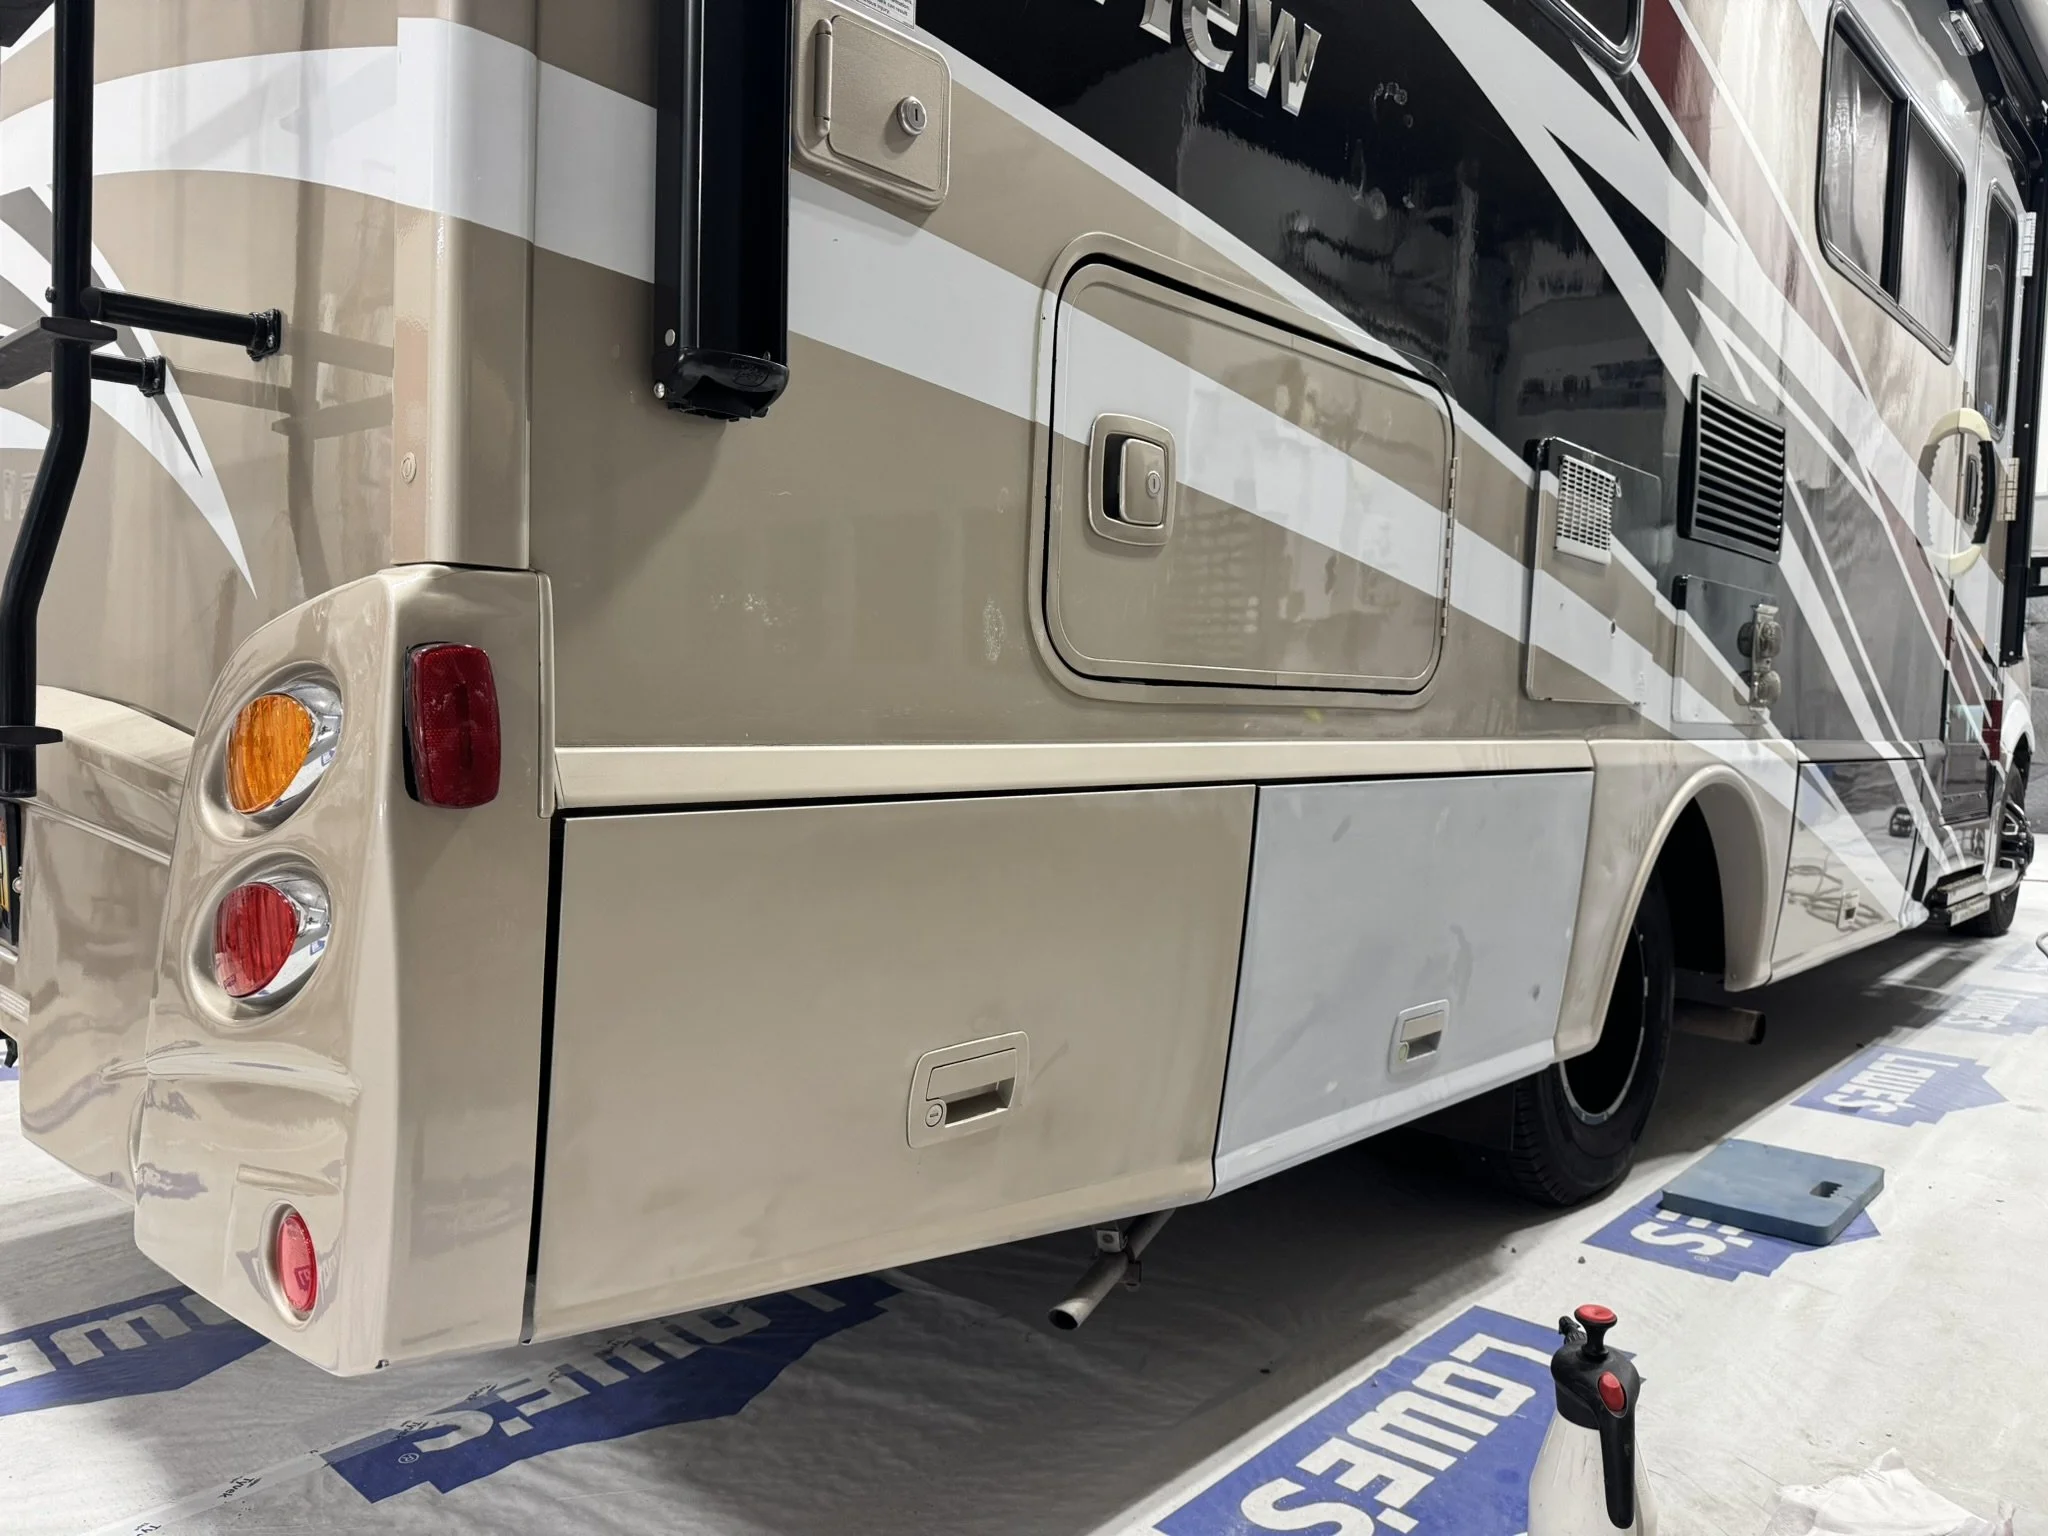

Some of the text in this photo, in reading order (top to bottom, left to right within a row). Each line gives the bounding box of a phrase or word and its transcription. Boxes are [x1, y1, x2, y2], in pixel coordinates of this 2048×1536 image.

[1095, 0, 1321, 117] ew
[1823, 1052, 1960, 1114] LOWE'S
[1241, 1332, 1552, 1536] LOWE'S
[217, 1476, 254, 1499] Tyvek
